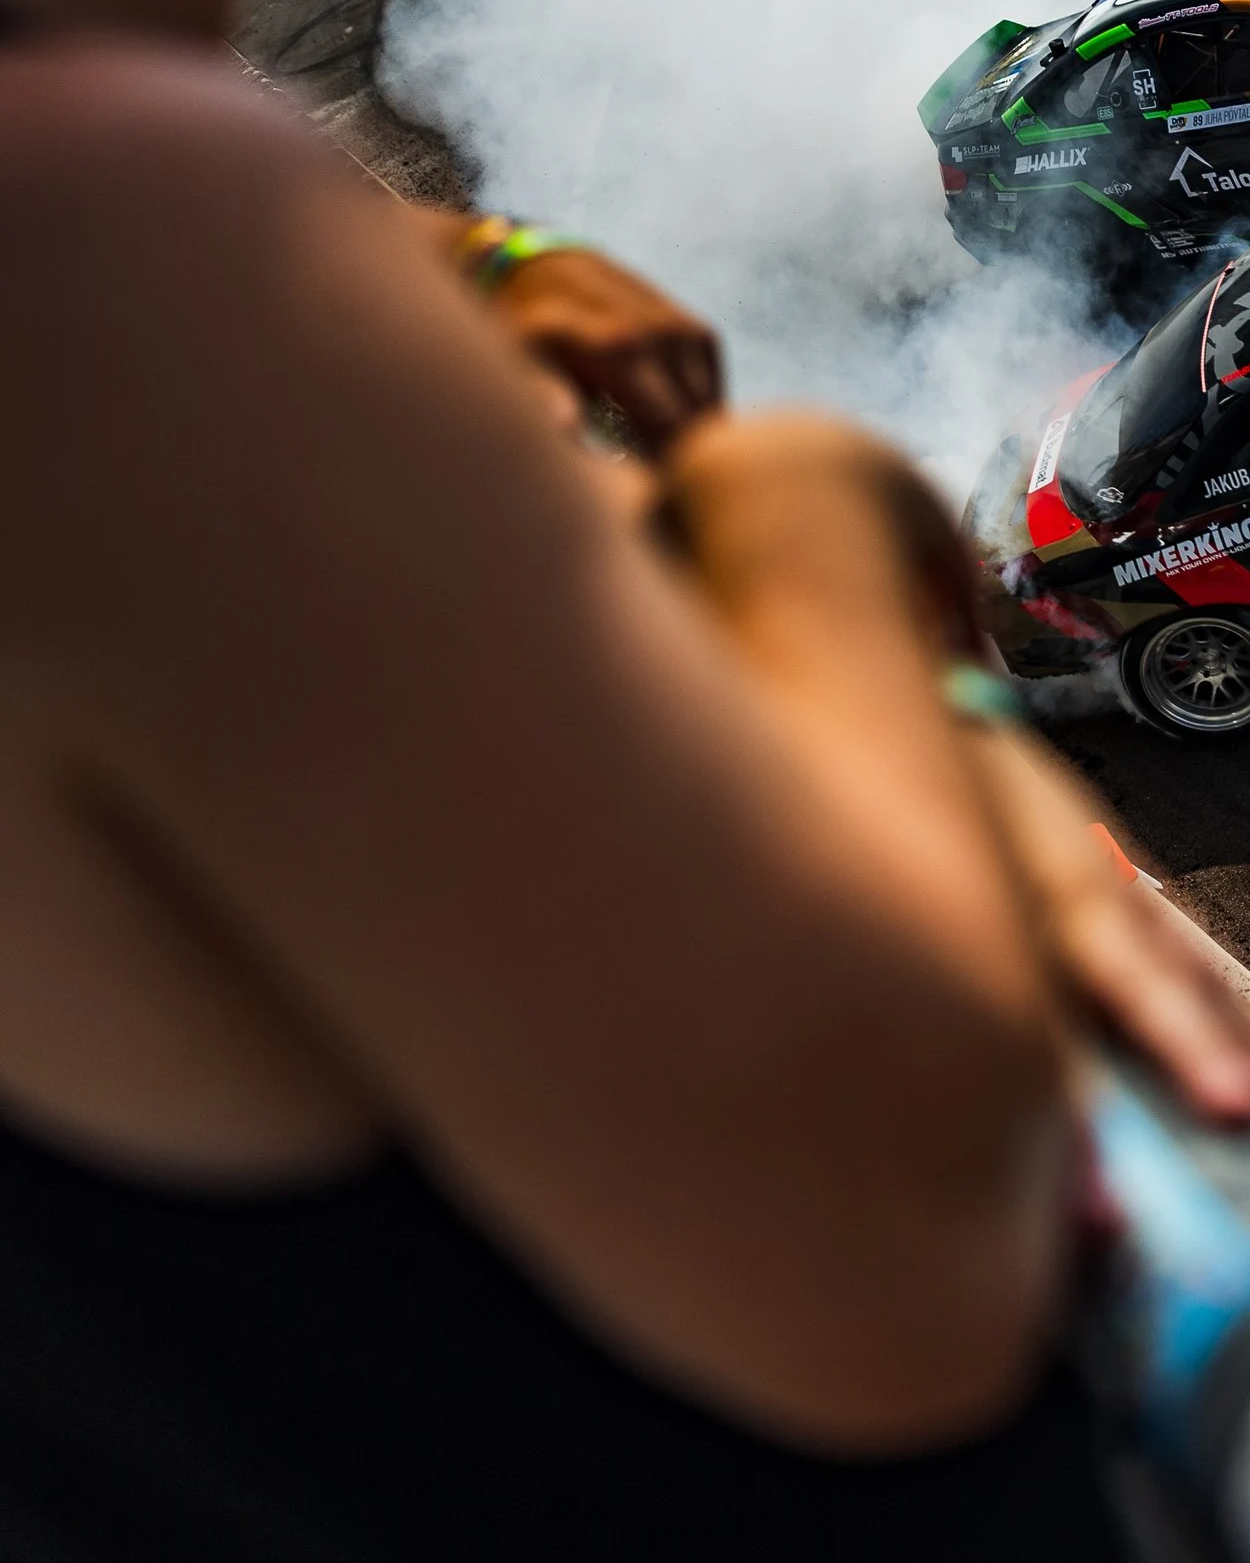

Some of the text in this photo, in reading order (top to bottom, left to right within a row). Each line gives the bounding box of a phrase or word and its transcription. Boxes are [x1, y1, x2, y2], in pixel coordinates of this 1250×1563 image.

[1132, 77, 1156, 96] SH
[1192, 115, 1203, 127] 89
[1204, 113, 1222, 126] JUHA
[1027, 147, 1088, 173] HALLIX
[1203, 468, 1250, 499] JAKUB
[1165, 568, 1180, 578] MIX
[1180, 560, 1203, 574] YOUR
[1202, 552, 1223, 566] OWN
